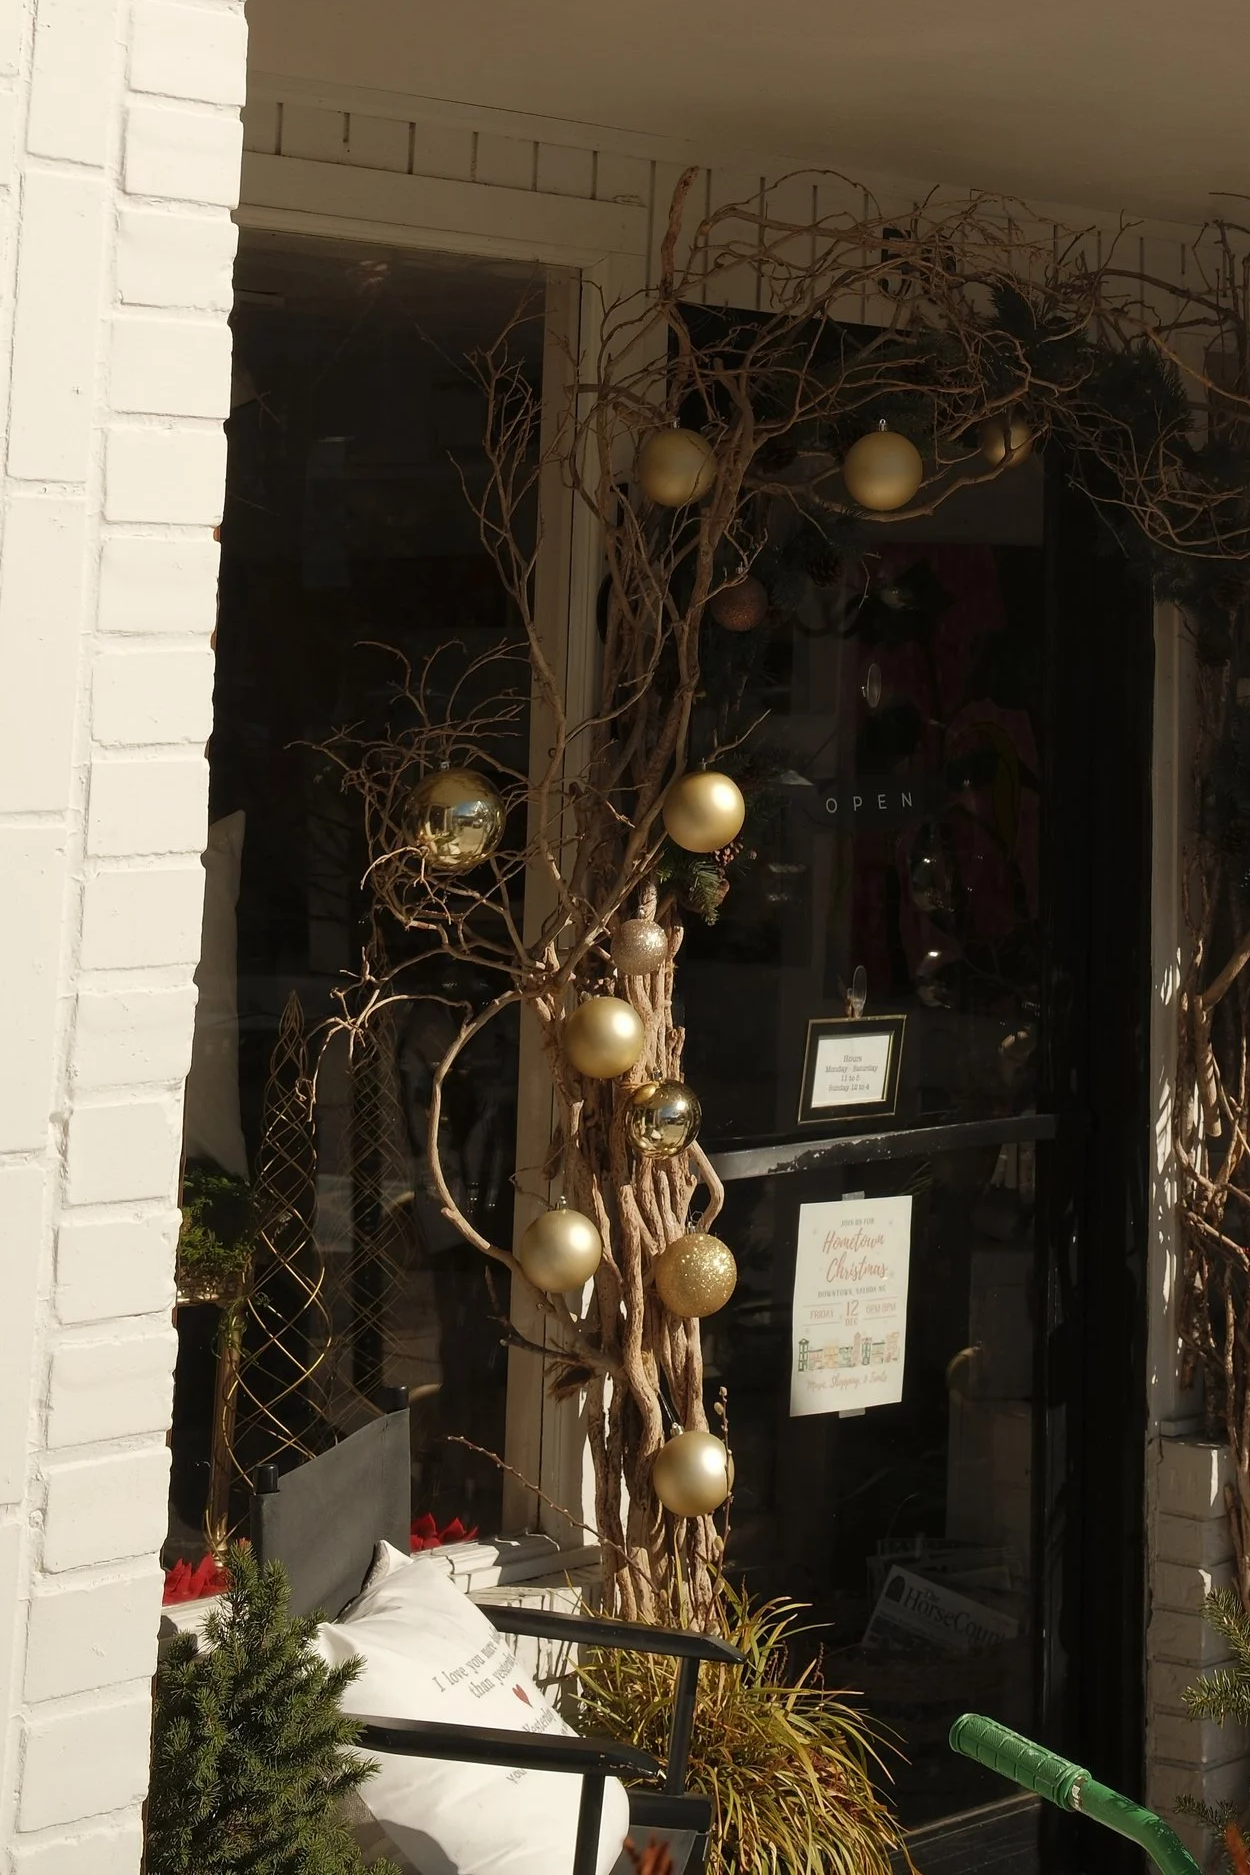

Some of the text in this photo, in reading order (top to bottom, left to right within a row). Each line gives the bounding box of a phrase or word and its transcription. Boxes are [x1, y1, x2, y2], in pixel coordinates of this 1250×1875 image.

[825, 791, 913, 814] OPEN
[843, 1054, 863, 1063] Hours
[822, 1227, 885, 1254] Hometown
[826, 1251, 888, 1283] Christmas
[845, 1299, 860, 1317] 12
[844, 1317, 859, 1327] DEC
[432, 1675, 446, 1693] I
[444, 1666, 470, 1686] love
[465, 1653, 486, 1675] you
[468, 1676, 496, 1699] than
